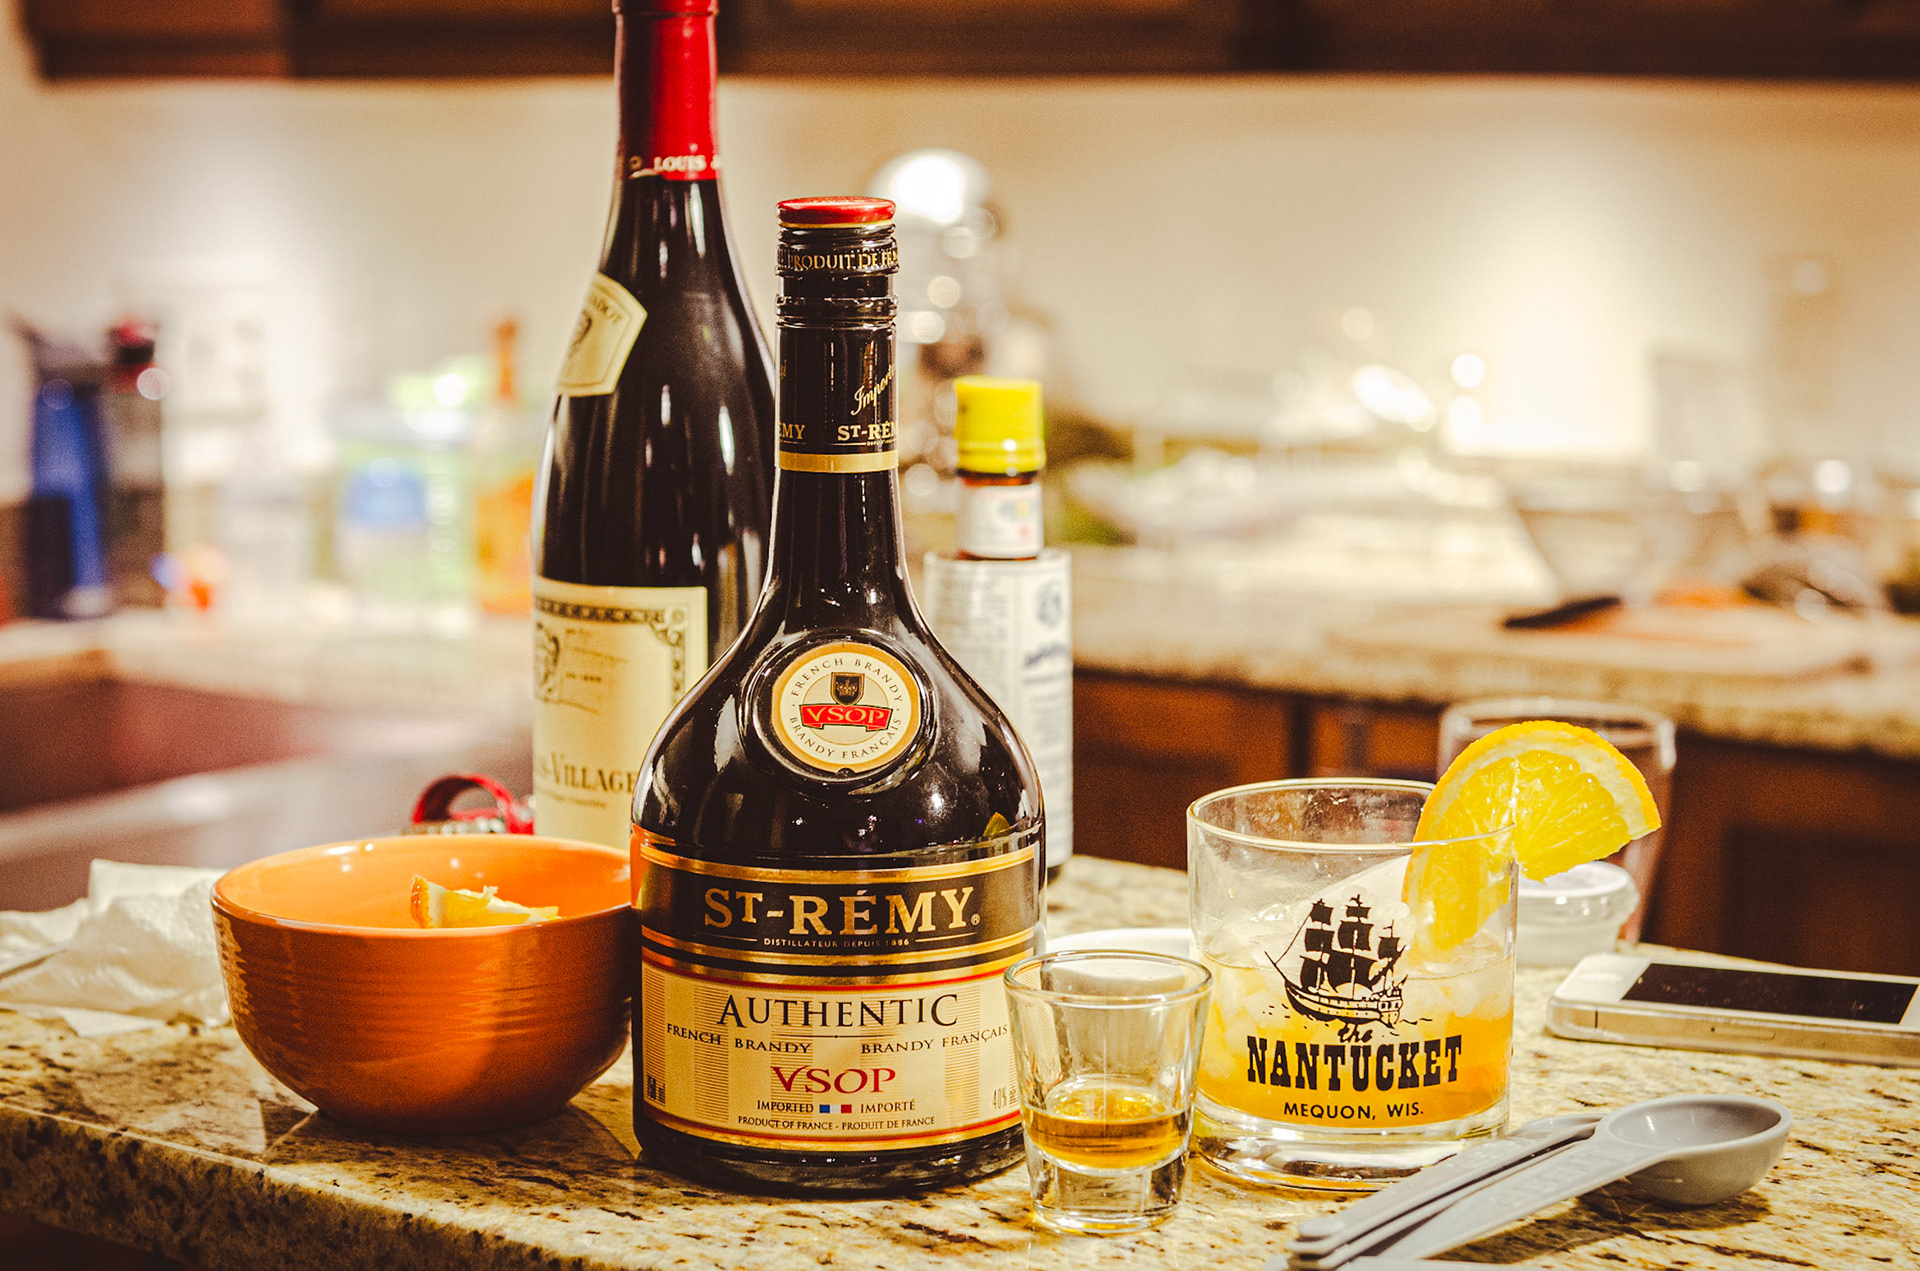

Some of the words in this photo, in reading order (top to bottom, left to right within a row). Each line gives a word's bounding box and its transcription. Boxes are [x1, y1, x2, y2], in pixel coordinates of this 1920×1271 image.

[654, 154, 707, 172] LOUIS
[787, 253, 855, 270] PRODUIT
[859, 252, 877, 267] DE
[790, 658, 843, 697] FRENCH
[855, 658, 903, 702] BRANDY
[807, 708, 885, 724] VSOP
[790, 717, 834, 757] BRANDY
[842, 719, 901, 759] FRANÇAIS
[763, 937, 838, 948] DISTILLATEUR
[843, 939, 881, 948] DEPUIS
[716, 993, 958, 1028] AUTHENTIC
[667, 1023, 721, 1045] FRENCH
[735, 1038, 812, 1053] BRANDY
[861, 1039, 934, 1054] BRANDY
[942, 1024, 1008, 1048] FRANÇAIS
[1337, 1024, 1373, 1043] the
[1246, 1035, 1462, 1092] NANTUCKET
[770, 1065, 896, 1094] VSOP
[757, 1100, 814, 1113] IMPORTED
[860, 1098, 915, 1113] IMPORTÉ
[1284, 1102, 1376, 1120] MEQUON,
[1387, 1102, 1424, 1117] WIS.
[738, 1115, 780, 1129] PRODUCT
[782, 1120, 795, 1129] OF
[797, 1121, 833, 1130] FRANCE
[842, 1121, 884, 1130] PRODUIT
[886, 1120, 898, 1129] DE
[901, 1116, 935, 1127] FRANCE
